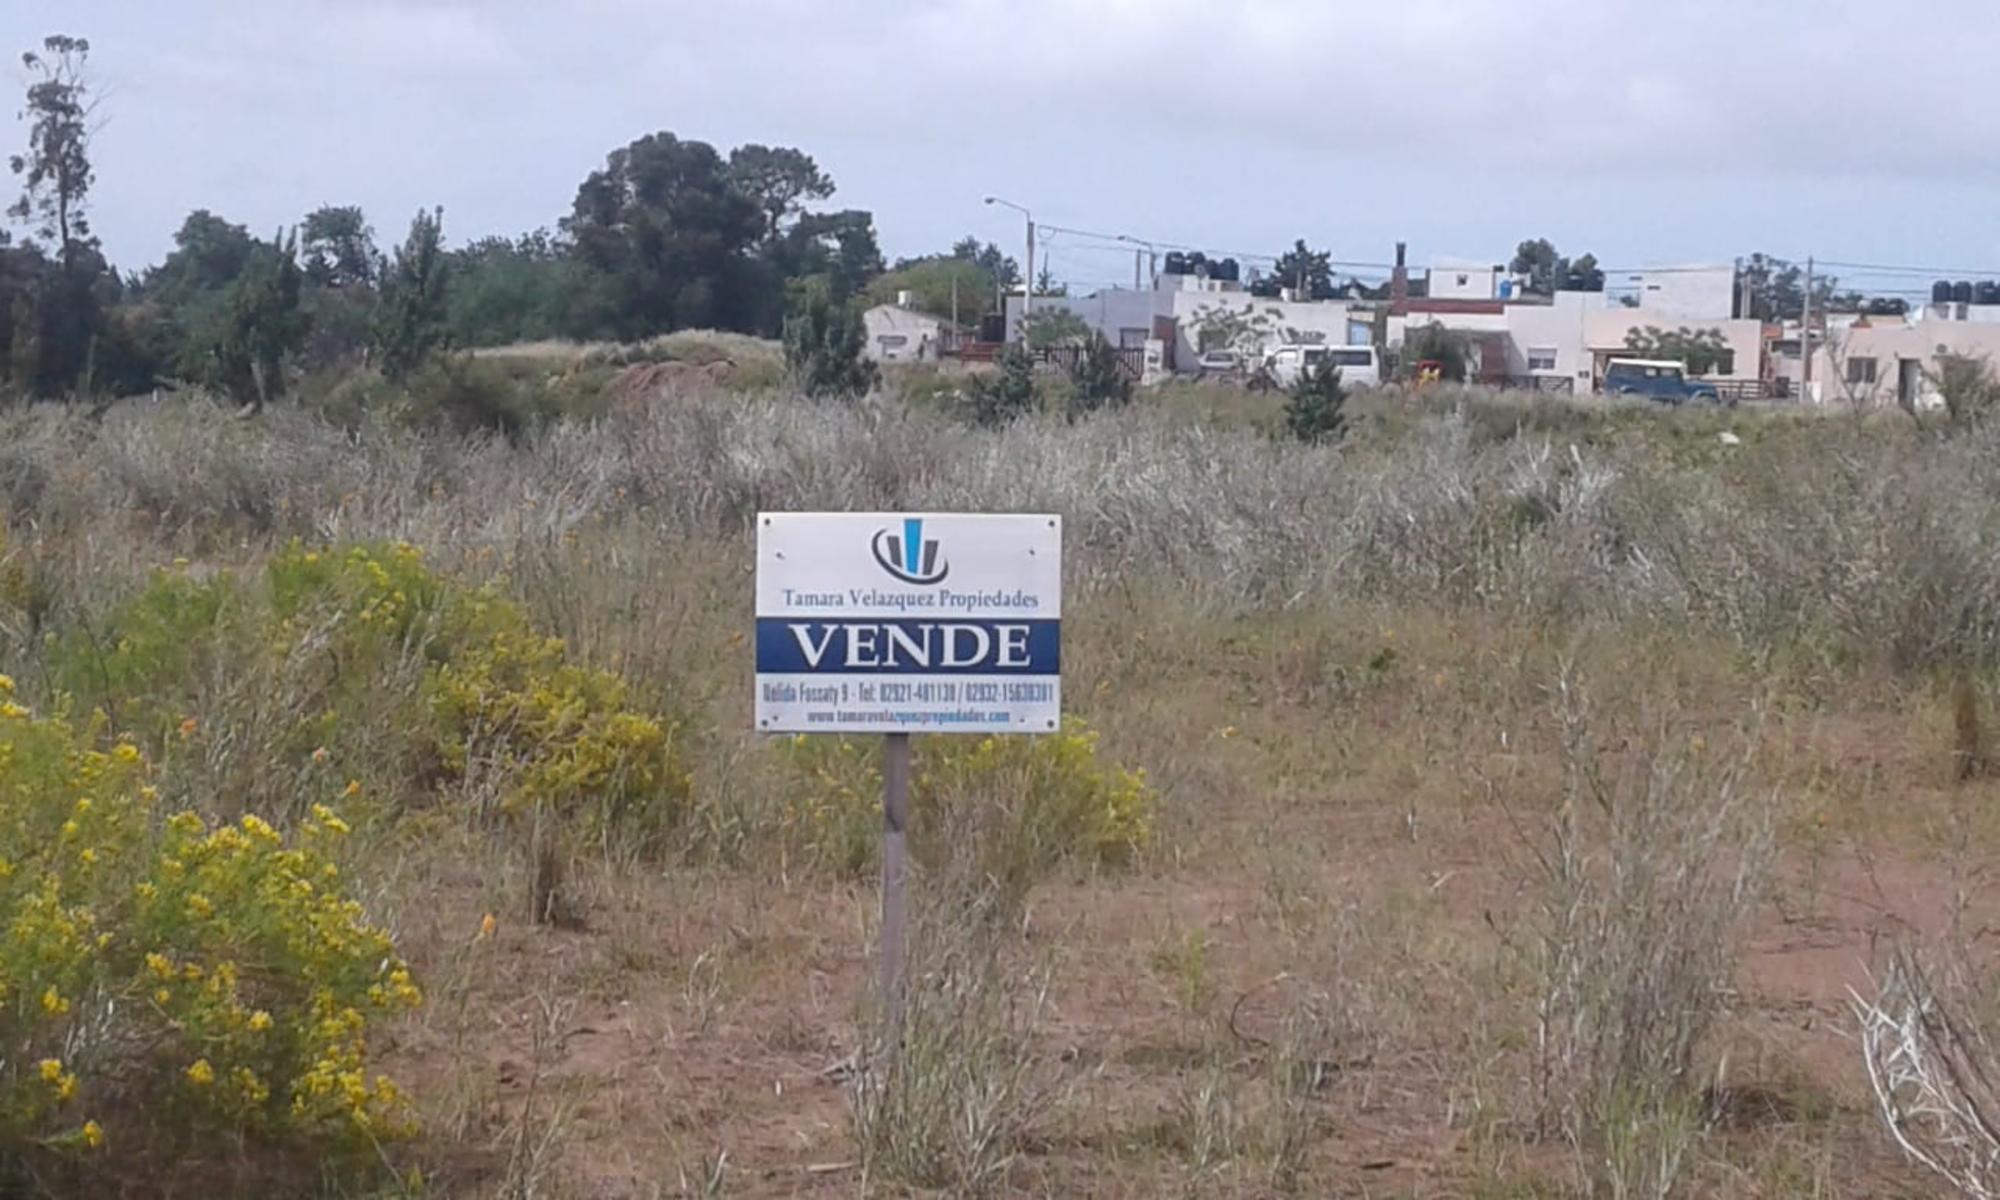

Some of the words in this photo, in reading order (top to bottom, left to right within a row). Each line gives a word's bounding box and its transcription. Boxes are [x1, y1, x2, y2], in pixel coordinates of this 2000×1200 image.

[783, 589, 844, 607] Tamara
[849, 589, 934, 611] Velazquez
[939, 589, 1039, 611] Propiedades
[788, 624, 1031, 668] VENDE
